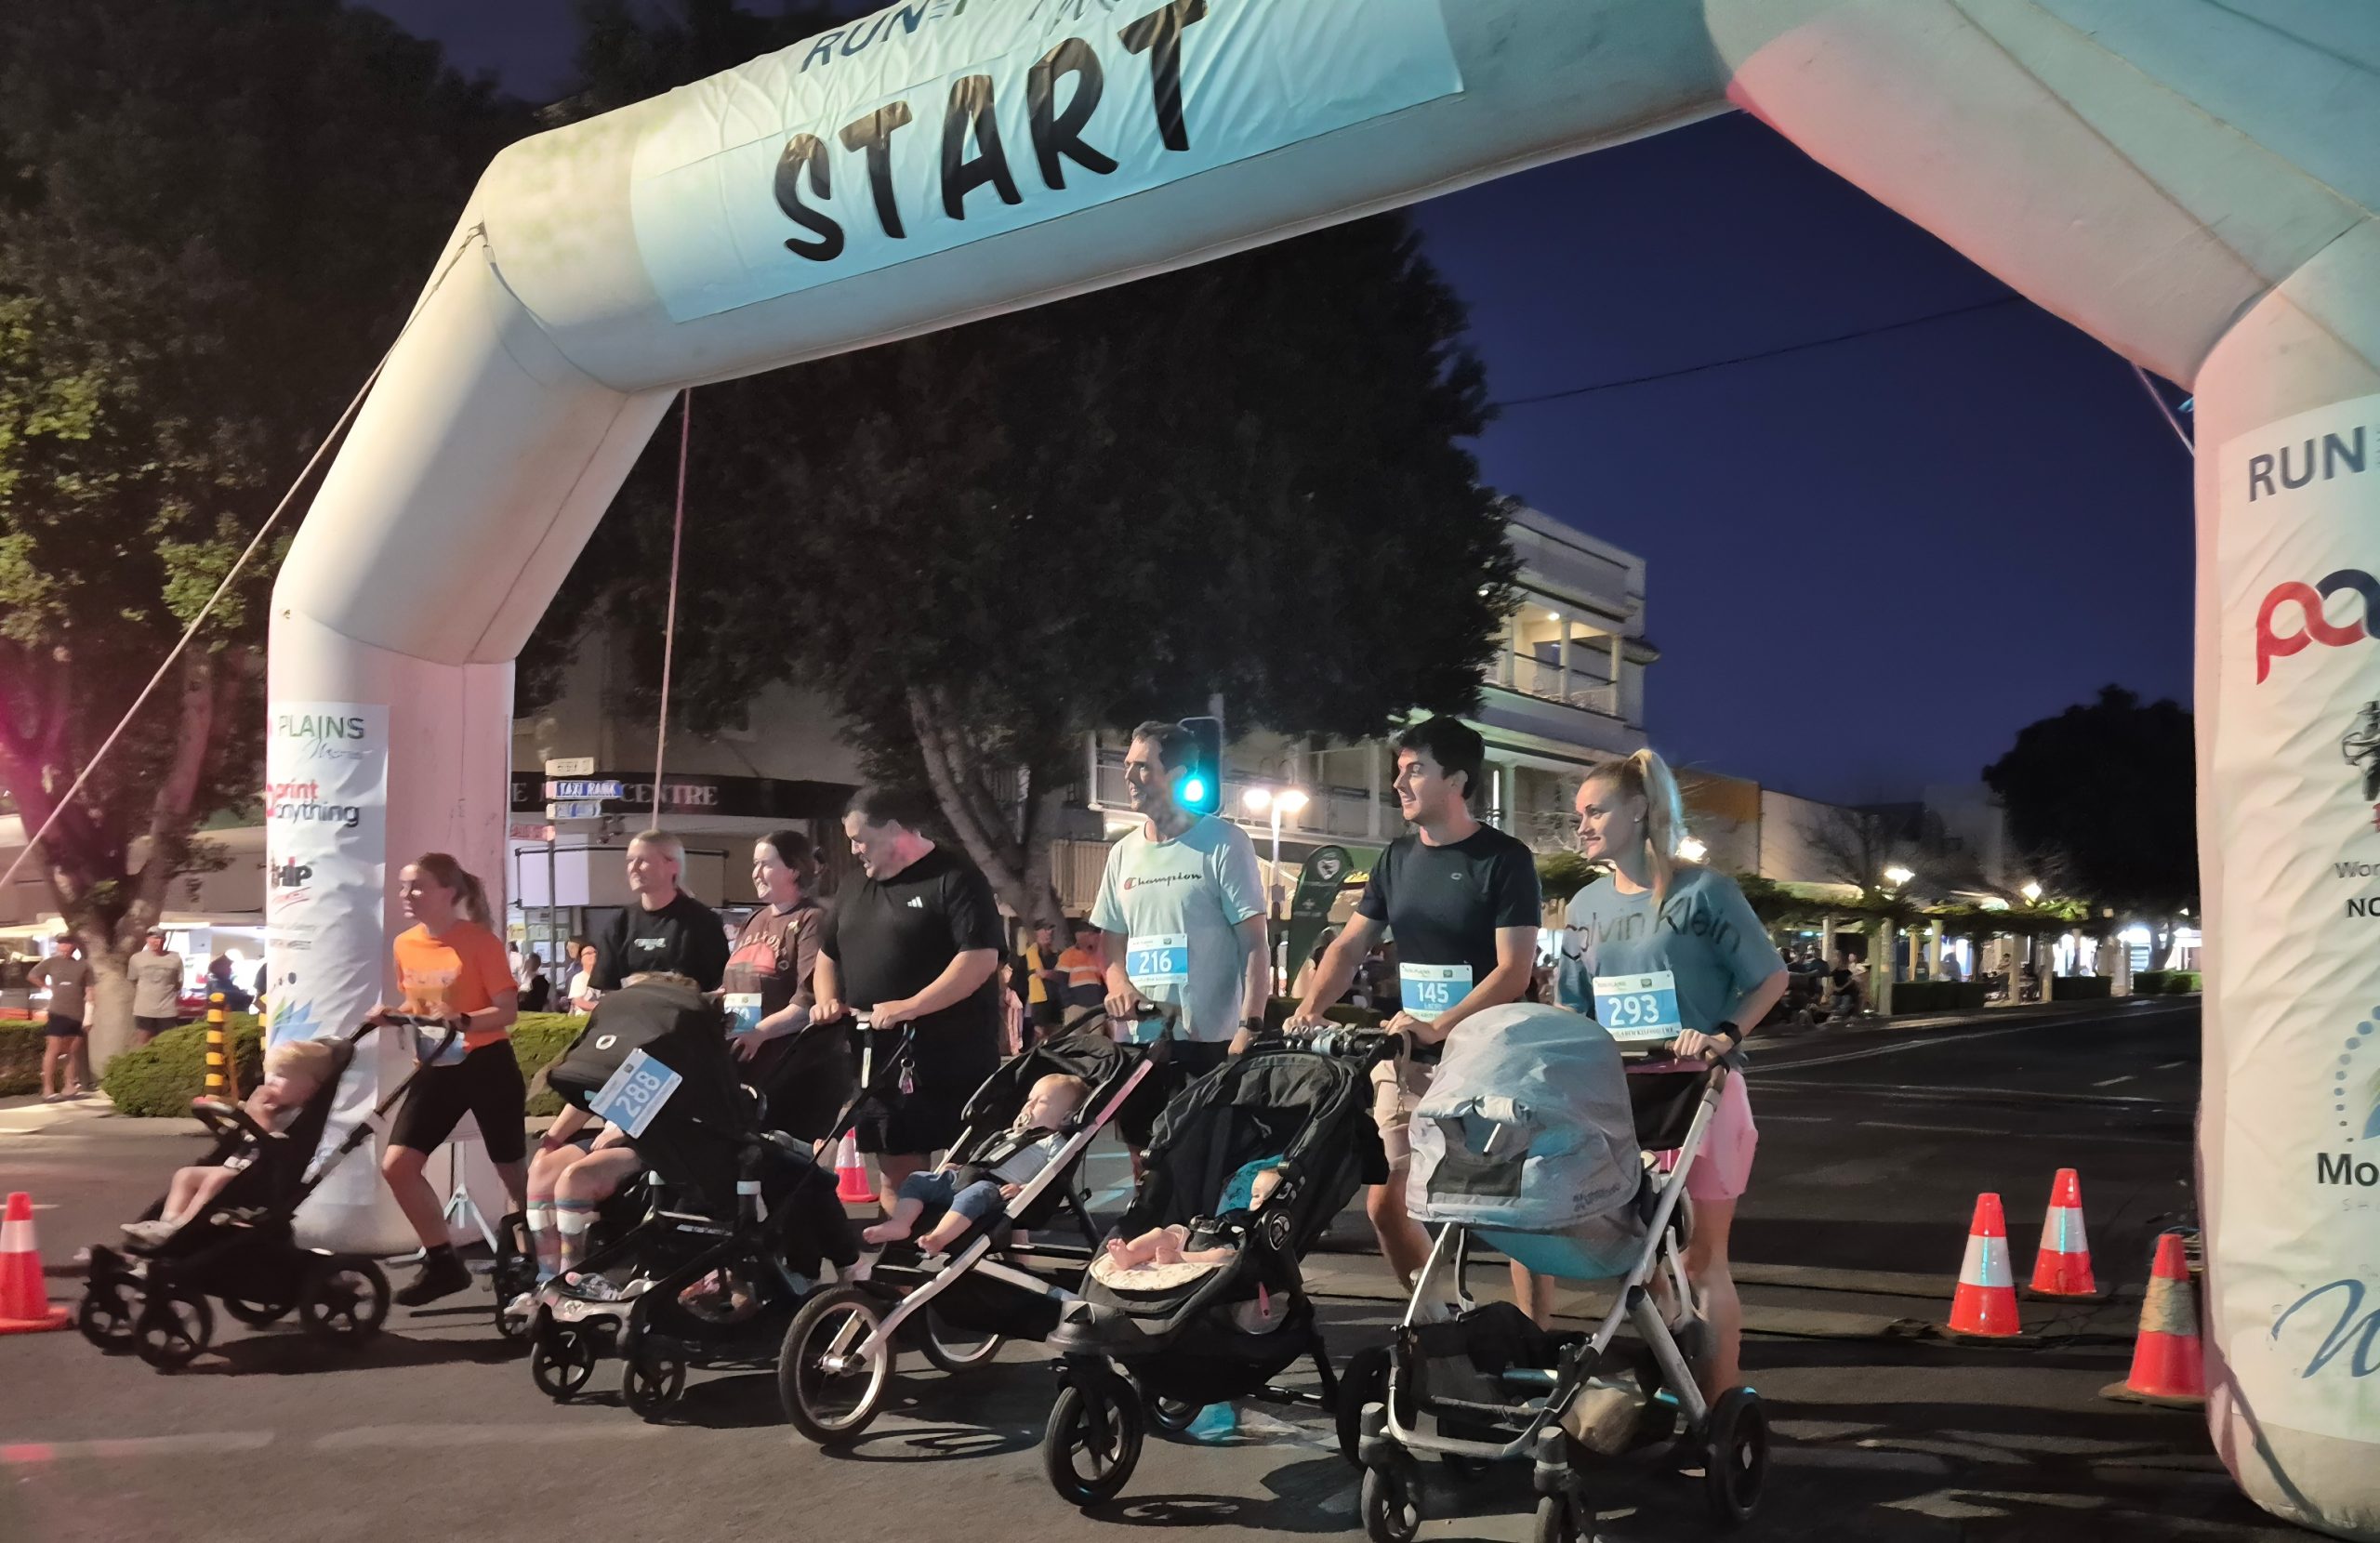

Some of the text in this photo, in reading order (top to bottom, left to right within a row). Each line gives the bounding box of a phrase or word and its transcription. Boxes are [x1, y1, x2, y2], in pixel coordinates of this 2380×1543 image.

[799, 0, 930, 73] RUN
[774, 0, 1209, 261] START
[2249, 425, 2367, 503] RUN
[1124, 872, 1202, 890] Champion
[1139, 949, 1172, 974] 216
[1418, 982, 1449, 1004] 145
[1608, 994, 1659, 1026] 293
[615, 1071, 661, 1117] 288
[2318, 1152, 2380, 1187] Mo
